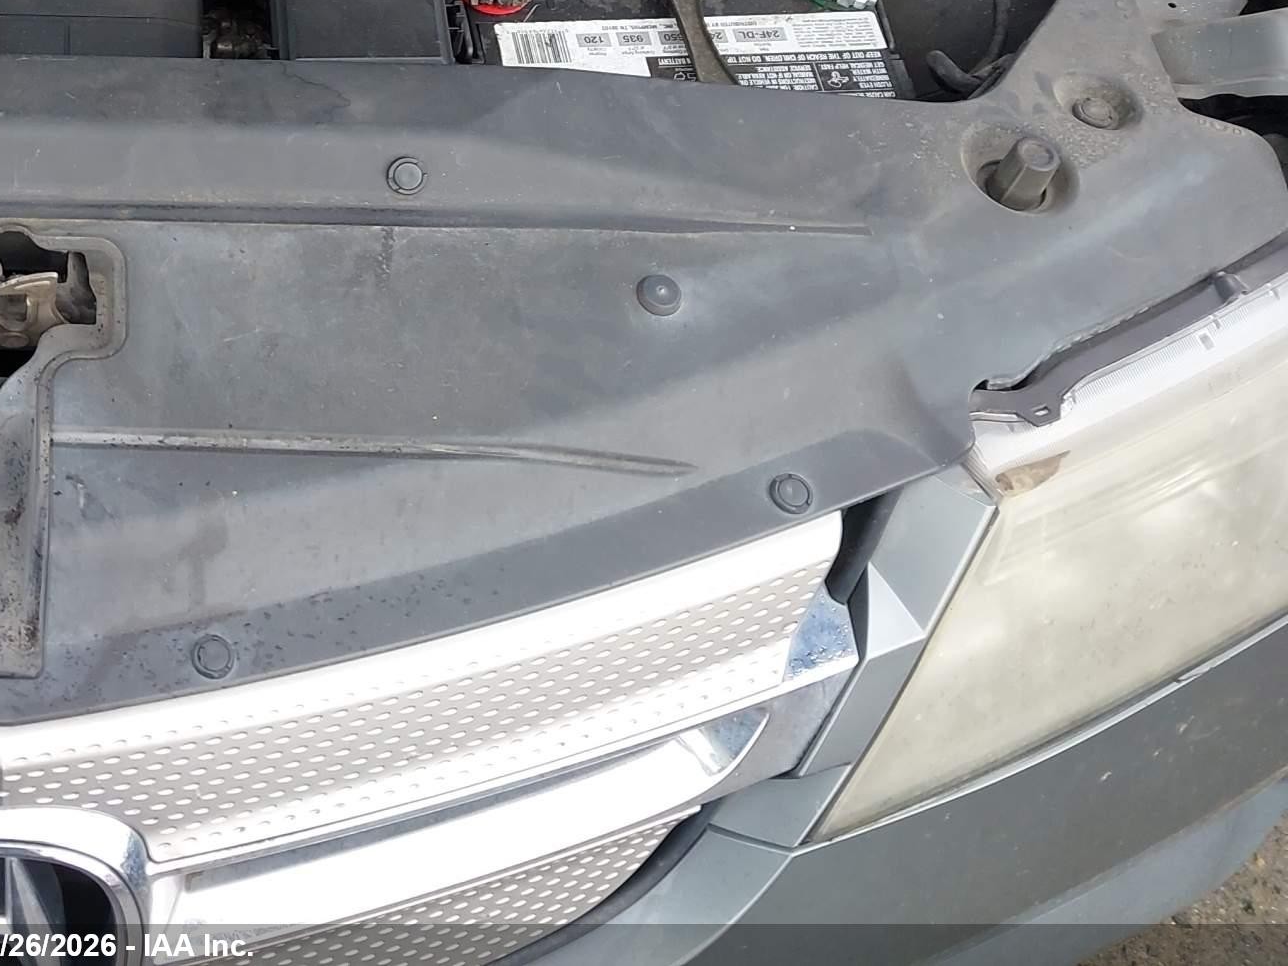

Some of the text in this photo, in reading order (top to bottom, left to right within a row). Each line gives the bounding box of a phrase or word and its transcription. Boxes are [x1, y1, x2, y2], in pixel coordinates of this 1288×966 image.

[738, 30, 780, 39] 24F-DL
[584, 36, 604, 44] 120
[806, 53, 827, 61] REACH
